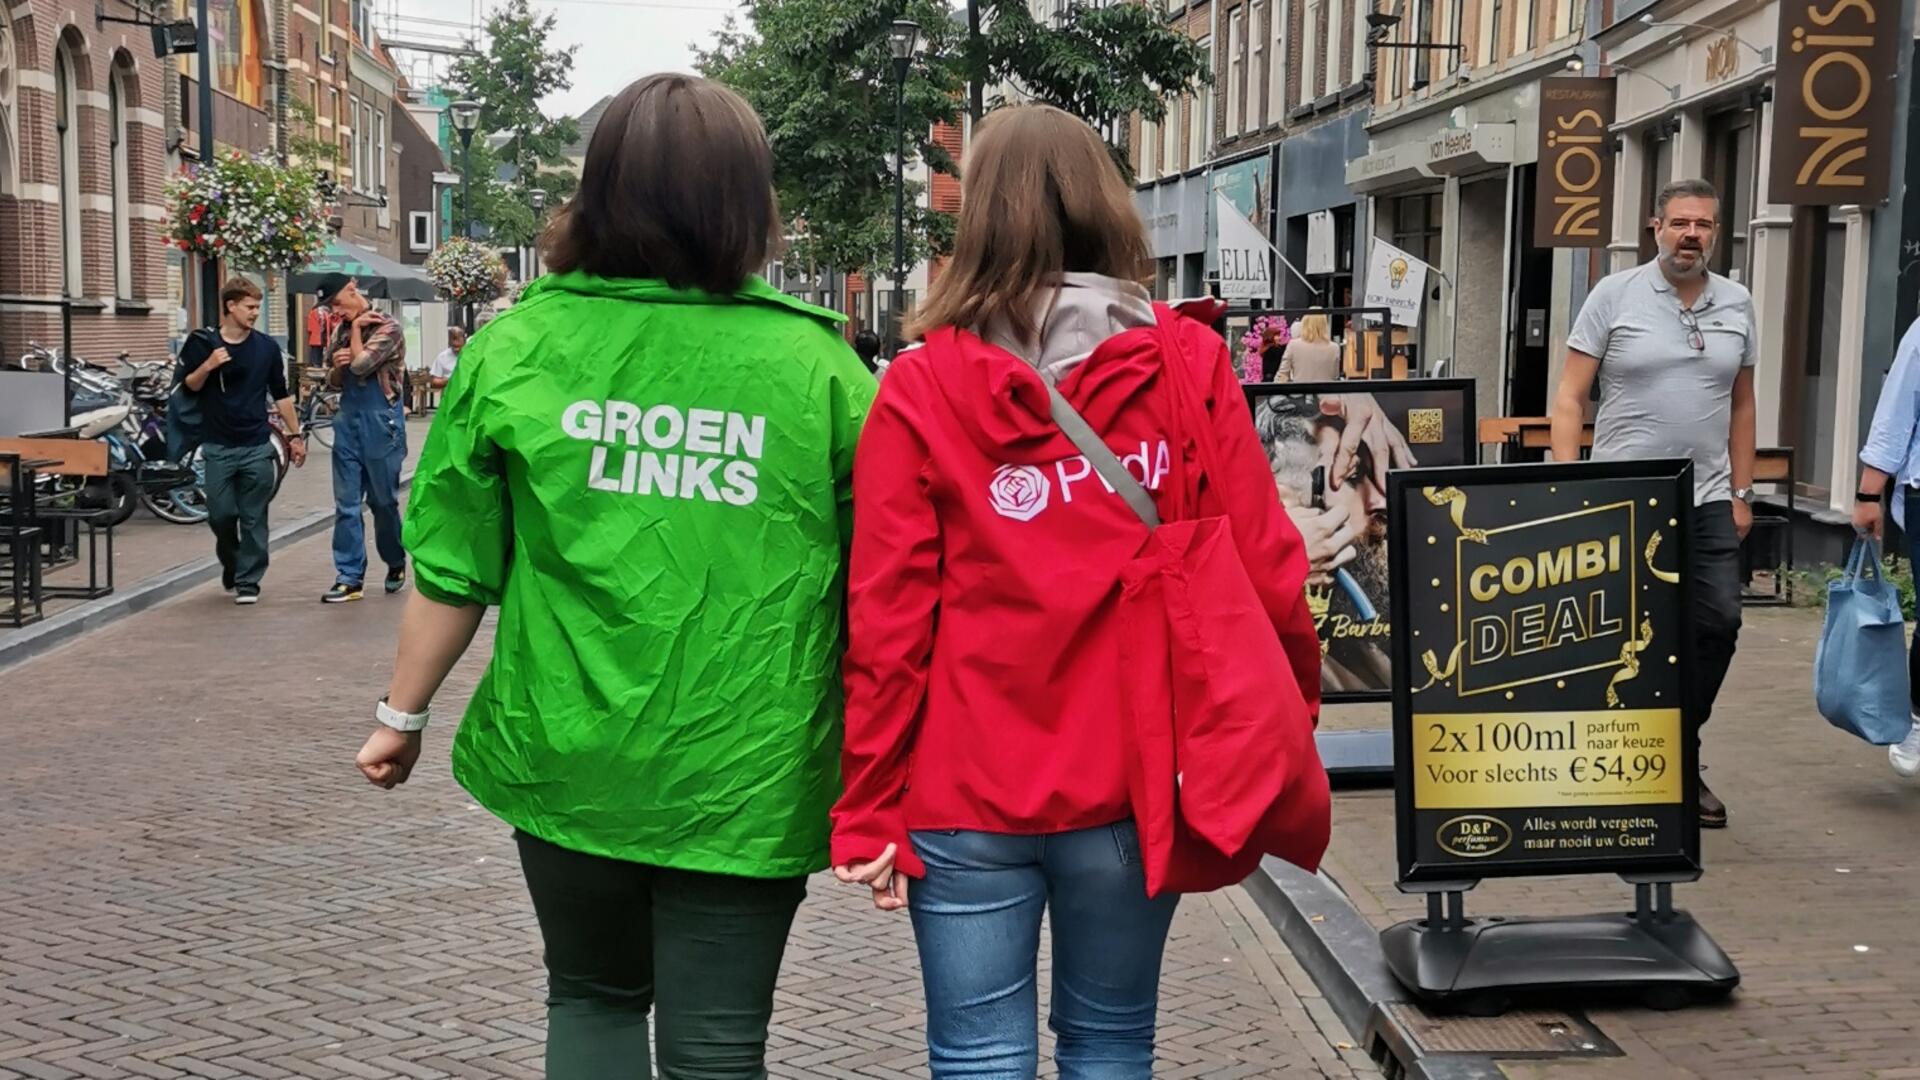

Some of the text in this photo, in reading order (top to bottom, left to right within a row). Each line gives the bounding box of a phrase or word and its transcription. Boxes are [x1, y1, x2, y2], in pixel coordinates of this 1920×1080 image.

[1546, 88, 1610, 100] RESTAURAN
[1547, 109, 1603, 235] NOÏS
[1221, 248, 1268, 281] ELLA
[561, 399, 766, 459] GROEN
[588, 446, 758, 506] LINKS
[1469, 534, 1621, 602] COMBI
[1469, 589, 1623, 666] DEAL
[1428, 720, 1577, 753] 2x100ml
[1587, 719, 1640, 736] parfum
[1587, 735, 1665, 750] naar keuze
[1426, 764, 1478, 784] Voor
[1485, 762, 1558, 783] slechts
[1460, 821, 1492, 835] D&P
[1522, 815, 1659, 832] Alles wordt vergeten,
[1524, 833, 1656, 849] maar nooit uw Geur!
